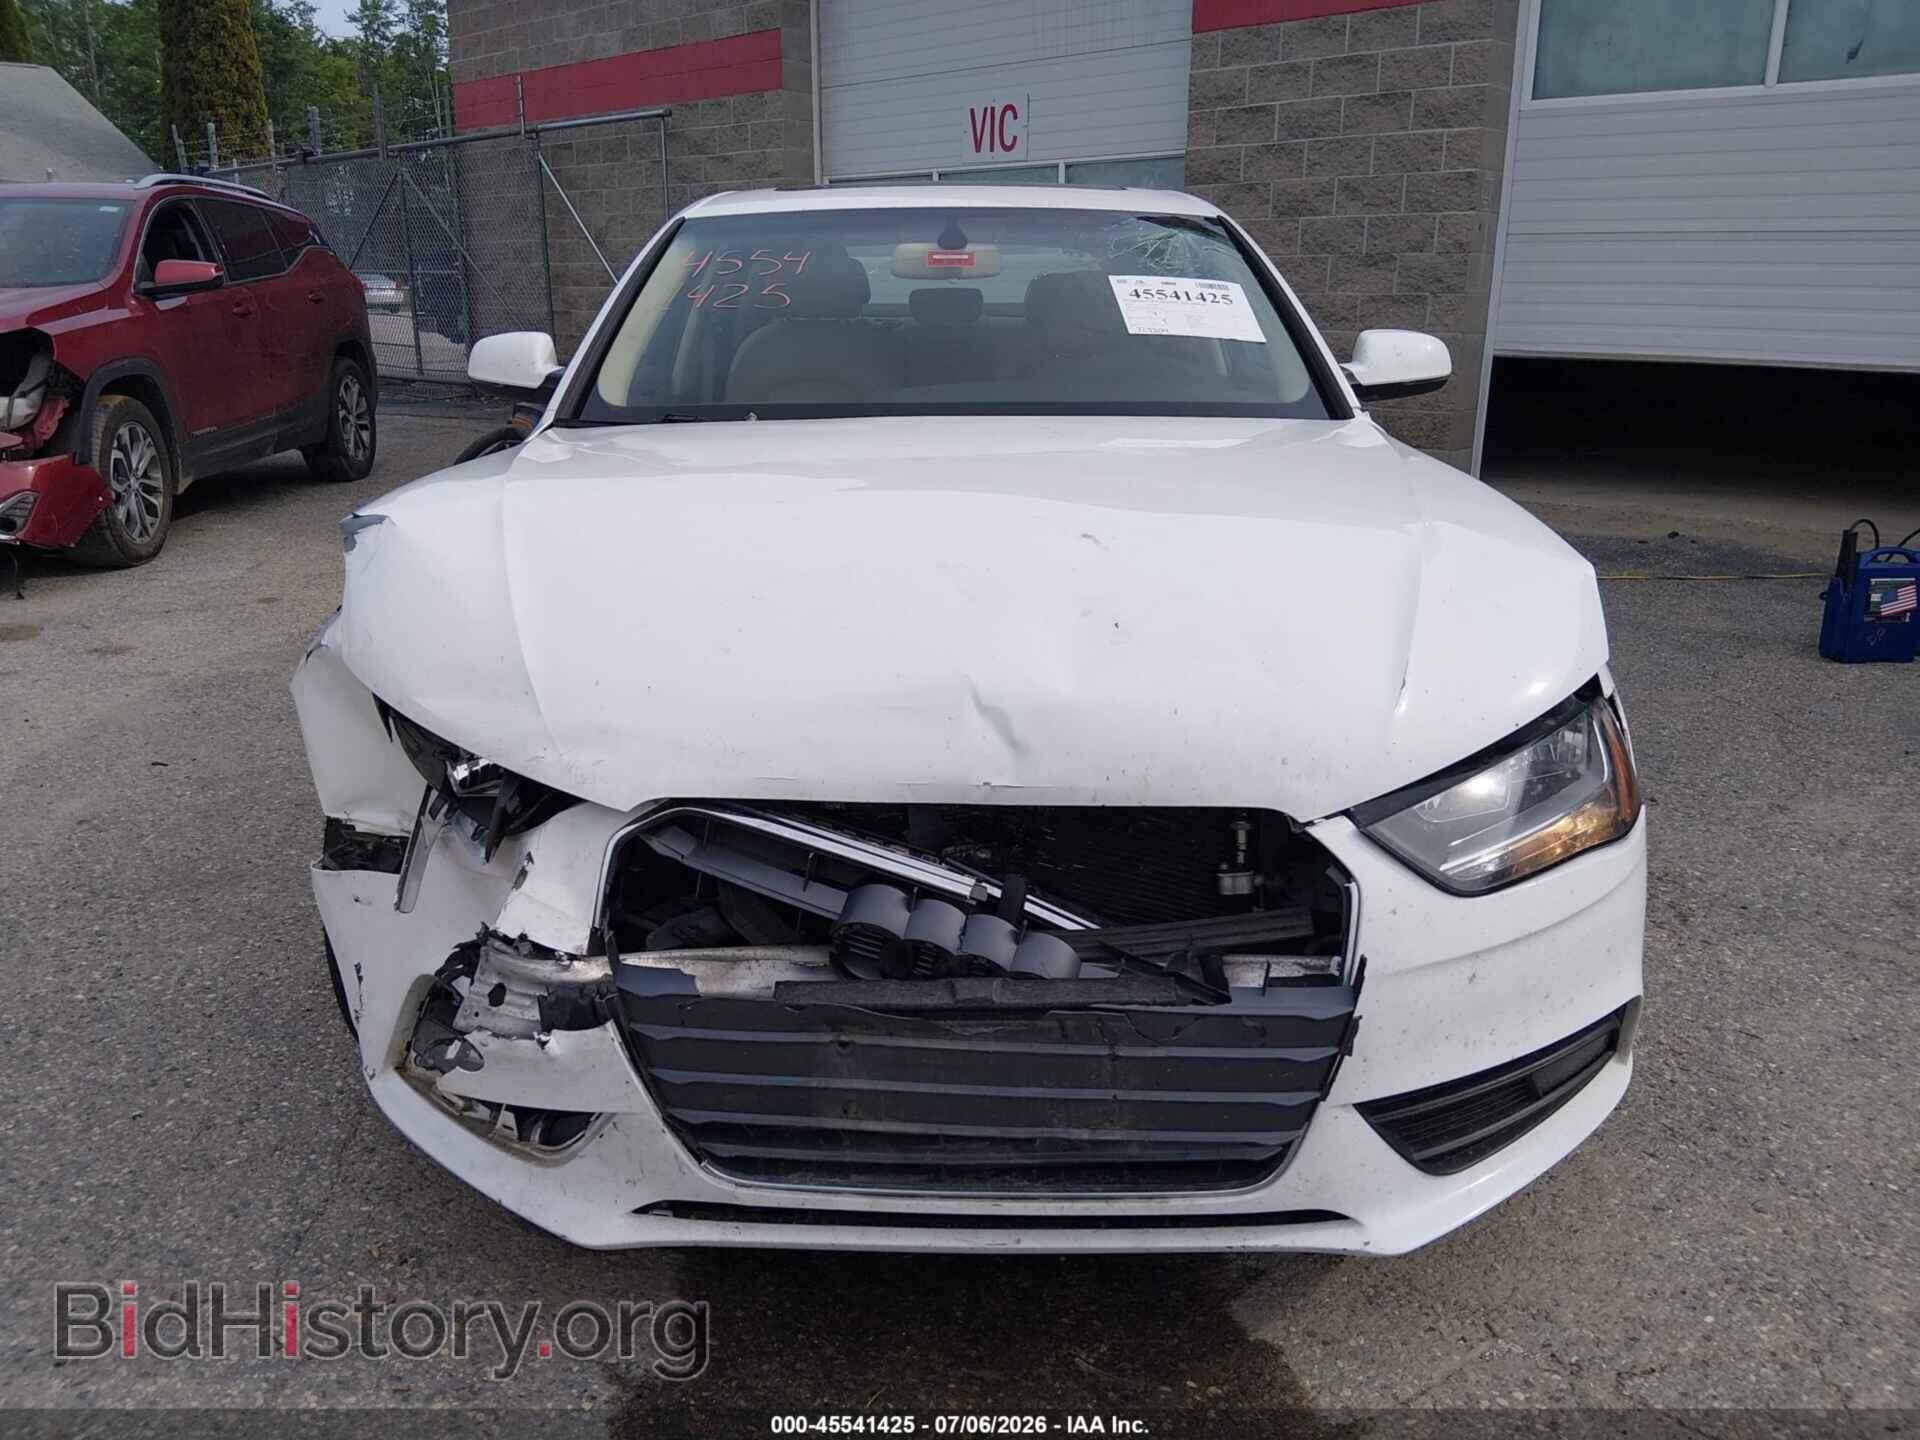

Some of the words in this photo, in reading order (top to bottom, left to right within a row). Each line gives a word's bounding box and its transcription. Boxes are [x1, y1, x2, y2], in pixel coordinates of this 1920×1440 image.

[969, 103, 1018, 154] VIC
[683, 249, 811, 278] 4554
[1129, 288, 1233, 304] 45541425
